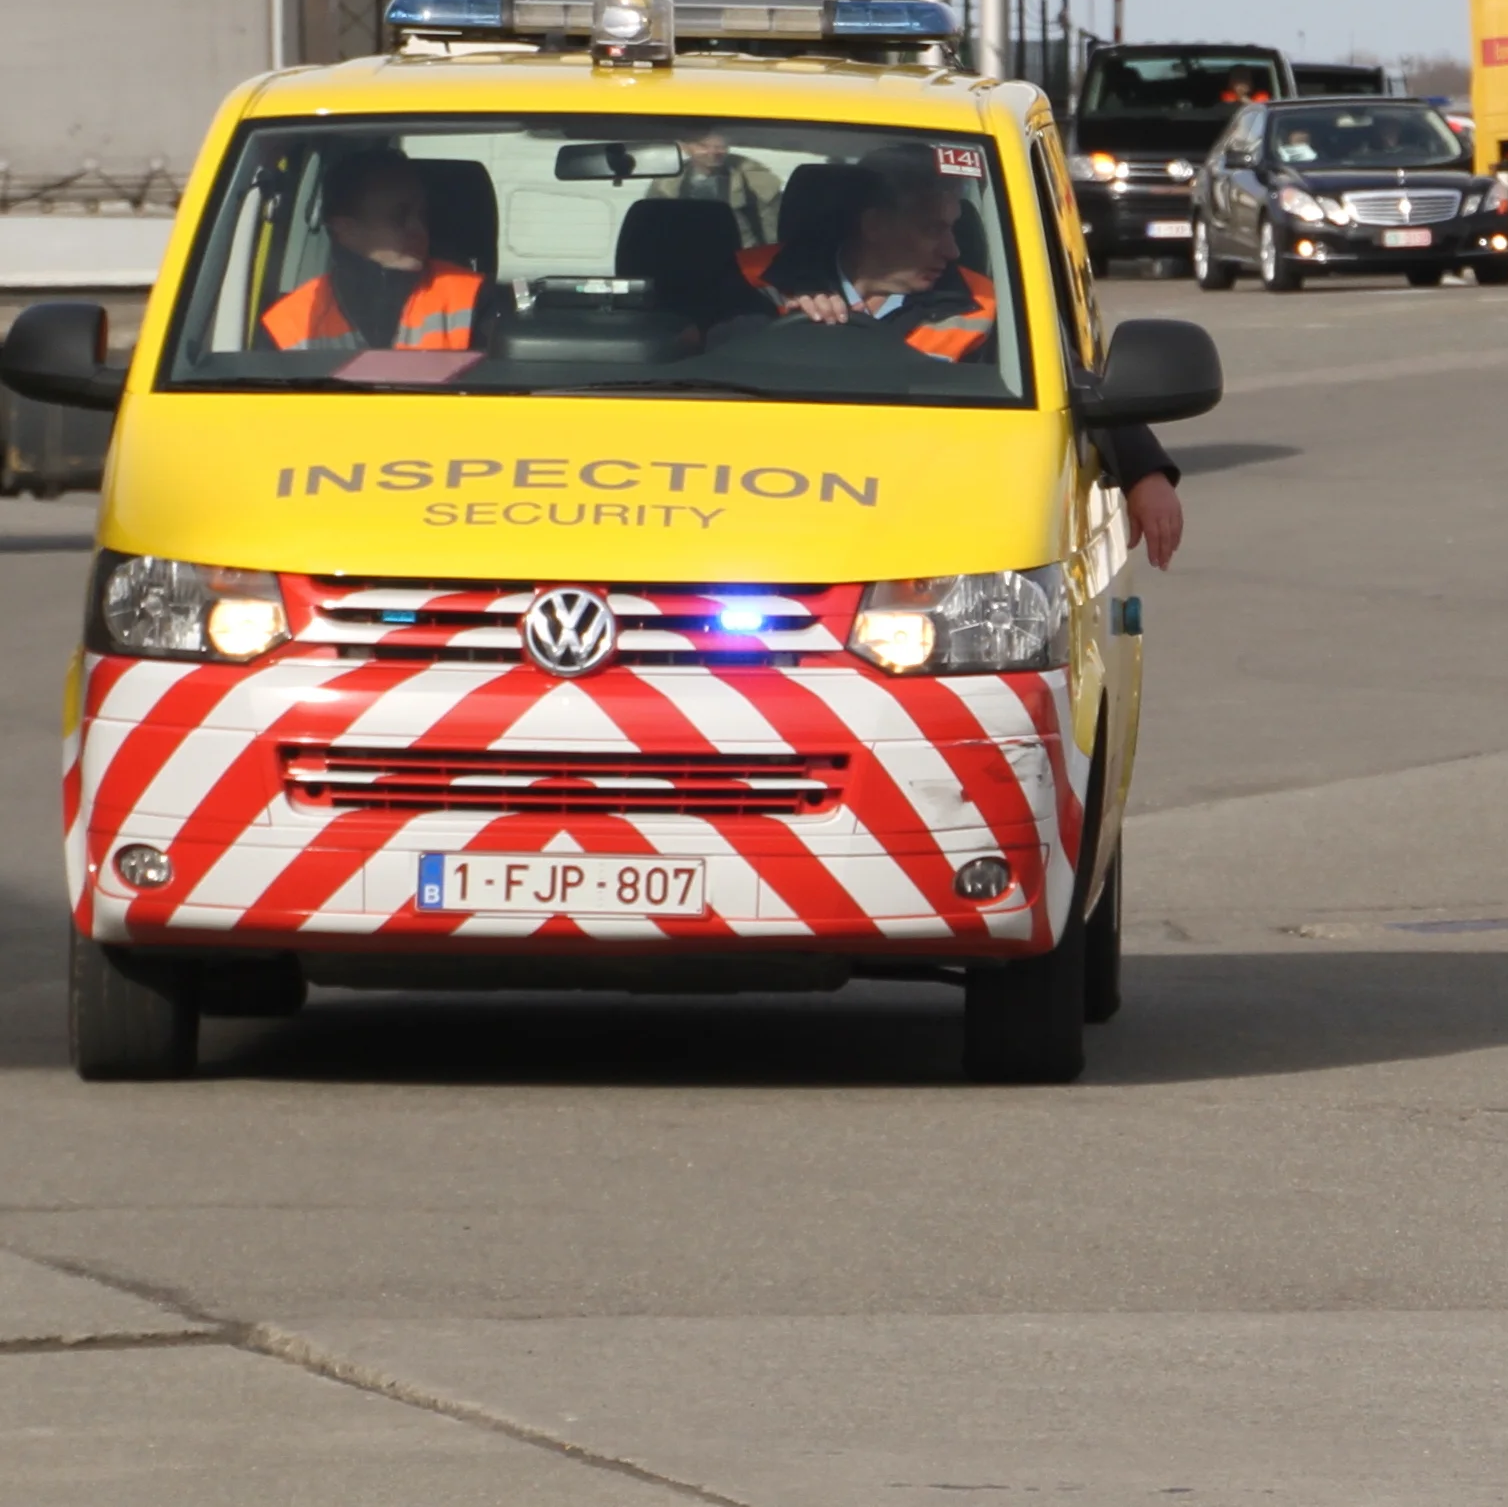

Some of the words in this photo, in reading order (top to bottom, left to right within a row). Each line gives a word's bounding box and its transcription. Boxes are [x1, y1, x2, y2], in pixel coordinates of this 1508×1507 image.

[276, 458, 879, 506] INSPECTION
[422, 502, 726, 529] SECURITY
[524, 588, 613, 672] VW
[423, 883, 440, 904] B
